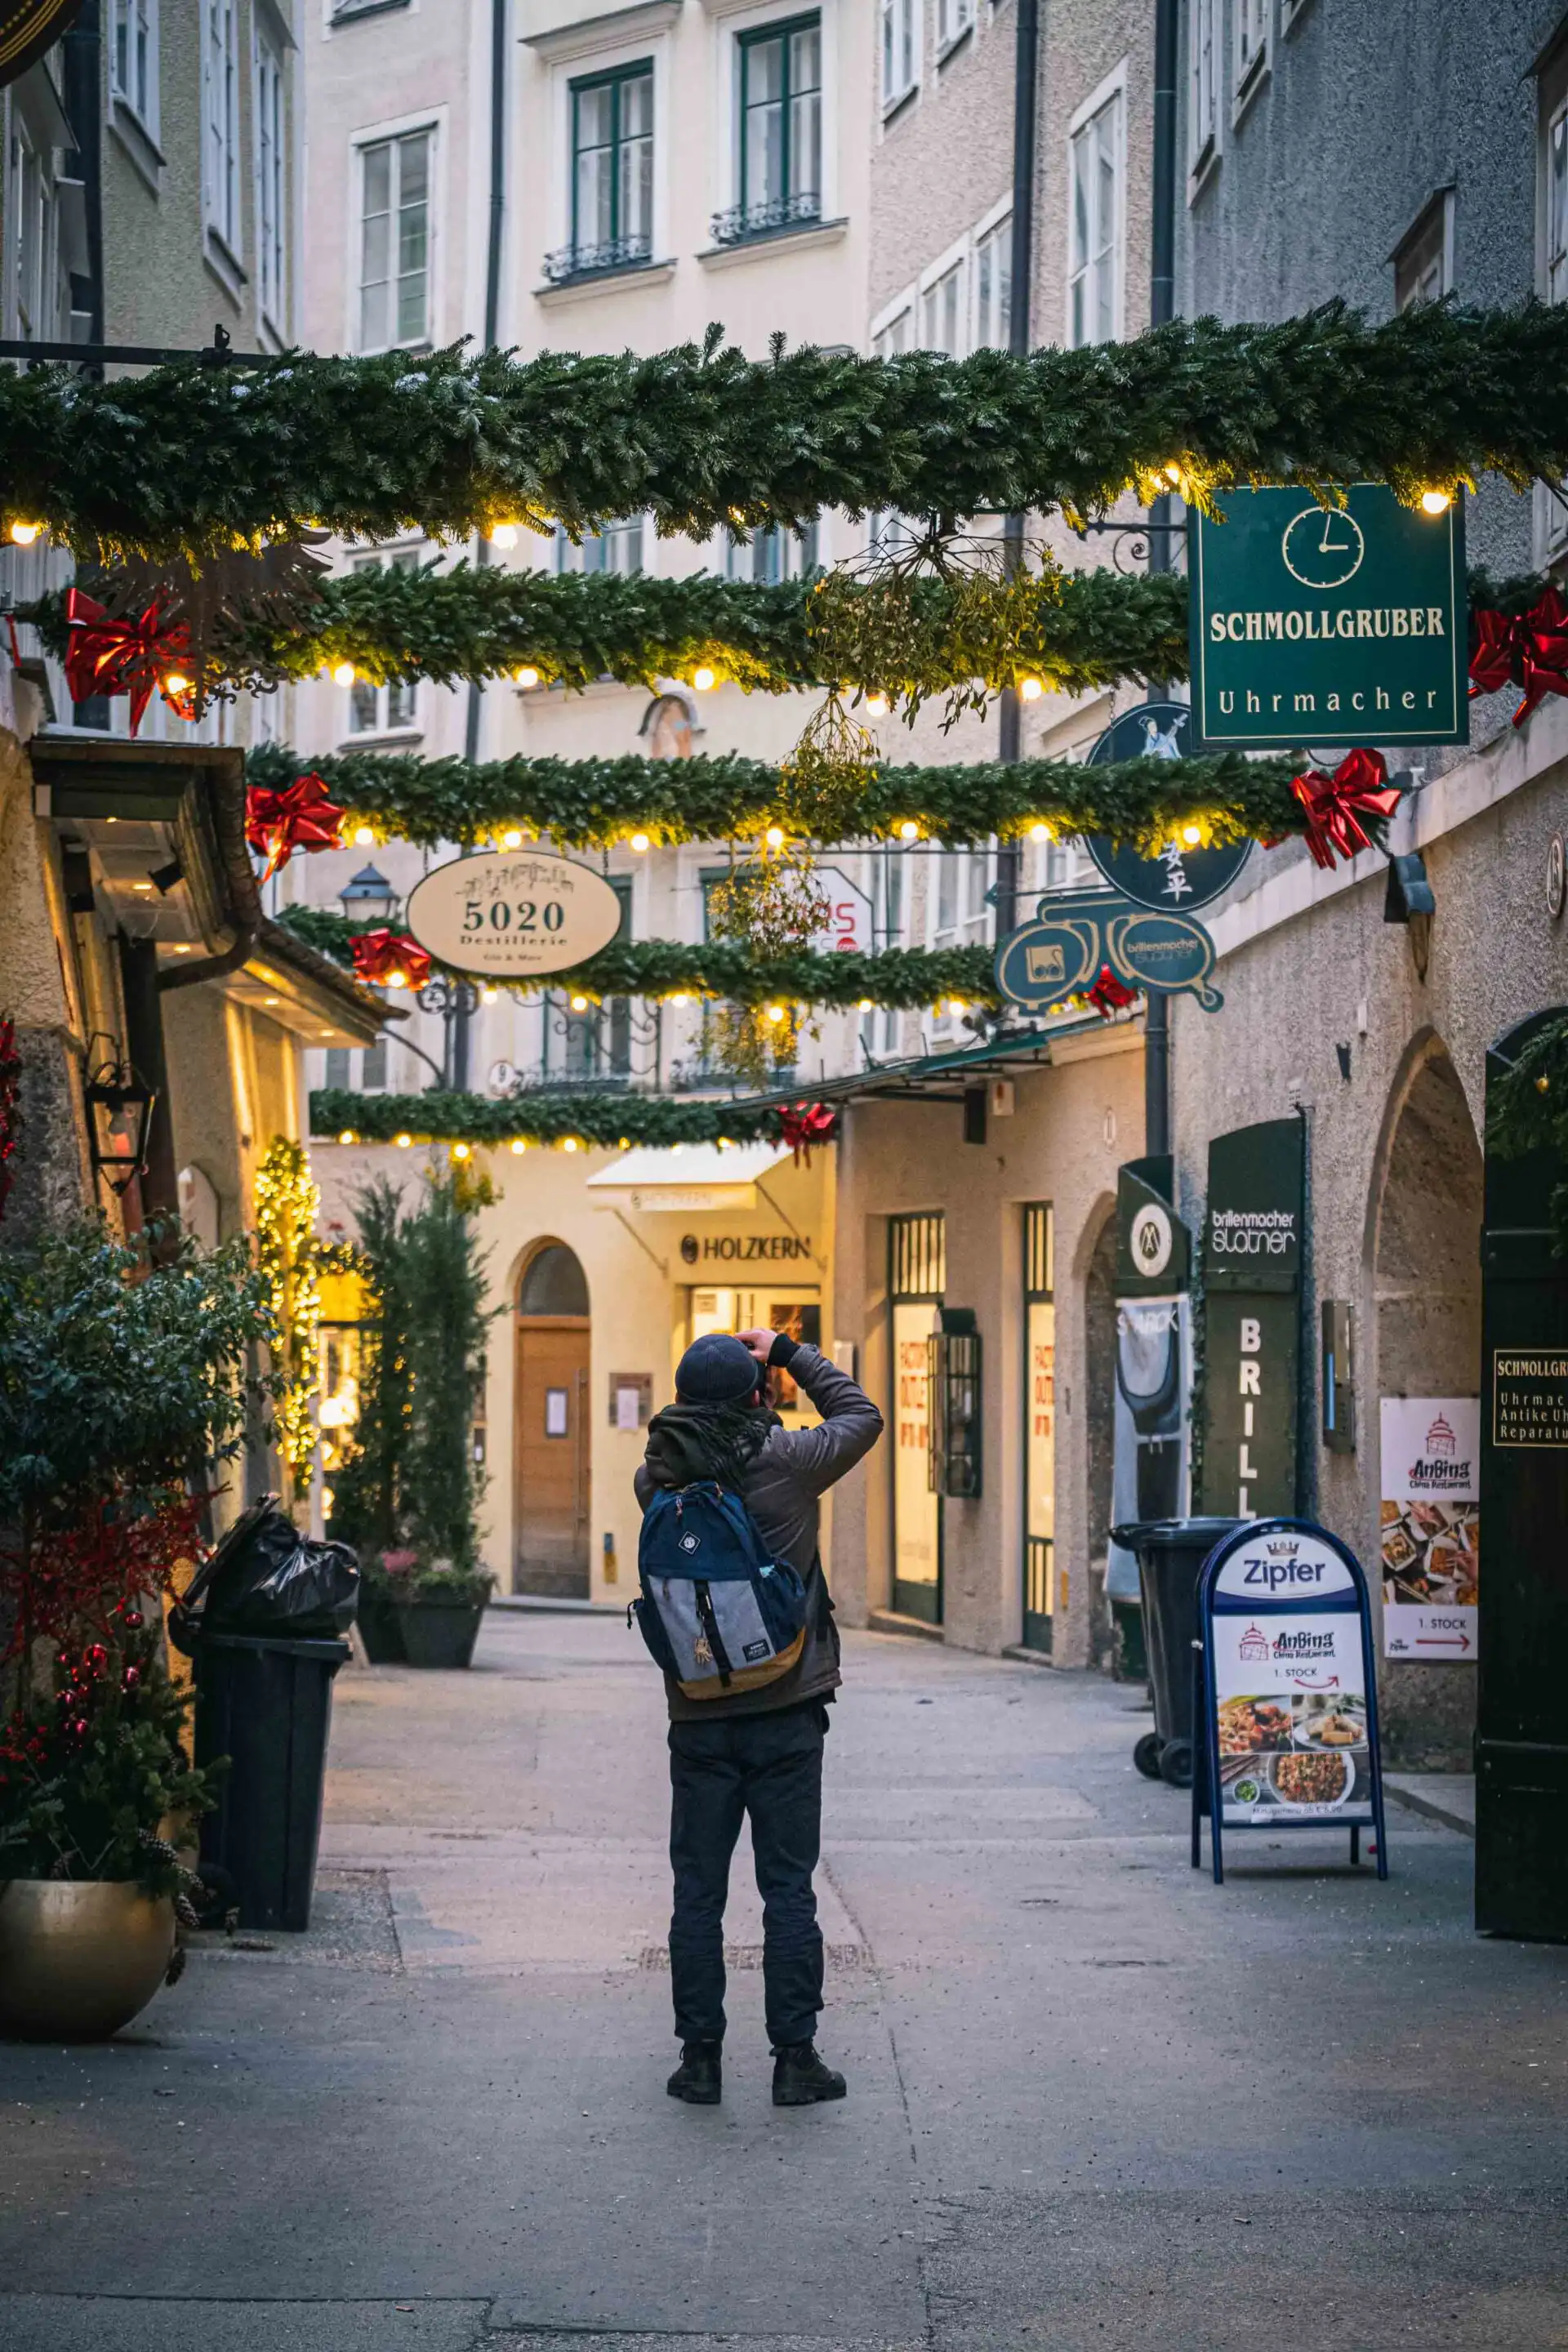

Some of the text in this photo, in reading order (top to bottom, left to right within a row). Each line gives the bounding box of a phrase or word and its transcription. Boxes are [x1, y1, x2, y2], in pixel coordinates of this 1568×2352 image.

[1210, 608, 1446, 642] SCHMOLLGRUBER
[1219, 687, 1437, 714] Uhrmacher
[463, 902, 564, 931] 5020
[460, 936, 567, 946] Destillerie
[1212, 1209, 1294, 1227] brillenmacher
[704, 1236, 810, 1260] HOLZKERN
[1498, 1360, 1568, 1378] SCHMOLLGR
[1501, 1408, 1548, 1422] Antike
[1414, 1459, 1472, 1479] AnBing
[1410, 1480, 1472, 1490] China Restaurant
[1244, 1558, 1325, 1592] Zipfer
[1431, 1618, 1467, 1630] STOCK
[1277, 1631, 1334, 1649] AnBing
[1273, 1648, 1336, 1659] China Restaurant
[1285, 1668, 1317, 1677] STOCK
